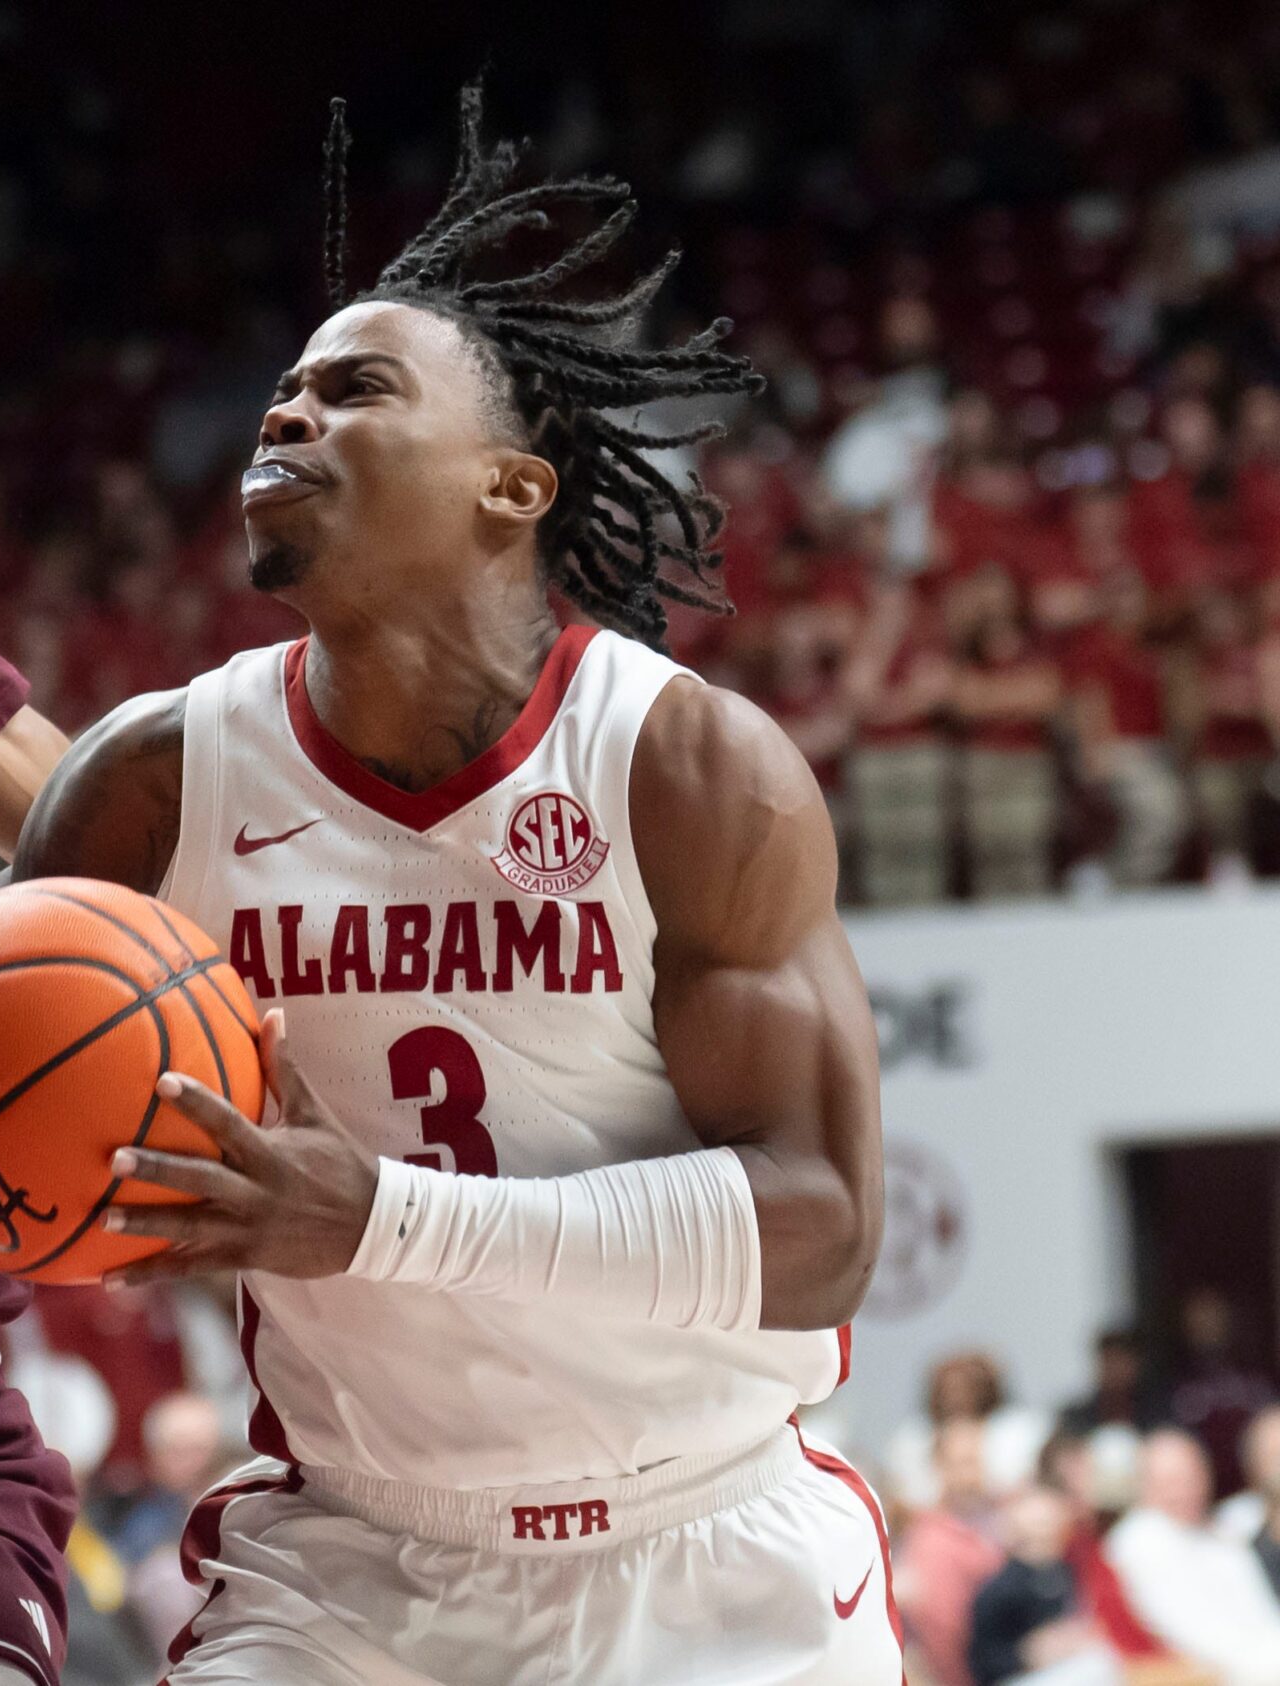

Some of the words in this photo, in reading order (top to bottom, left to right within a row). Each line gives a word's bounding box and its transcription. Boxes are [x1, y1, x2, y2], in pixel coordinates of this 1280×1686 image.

[513, 796, 586, 870] SEC
[507, 860, 597, 893] GRADUATE
[230, 900, 623, 999] ALABAMA
[387, 1025, 498, 1178] 3
[511, 1499, 611, 1541] RTR
